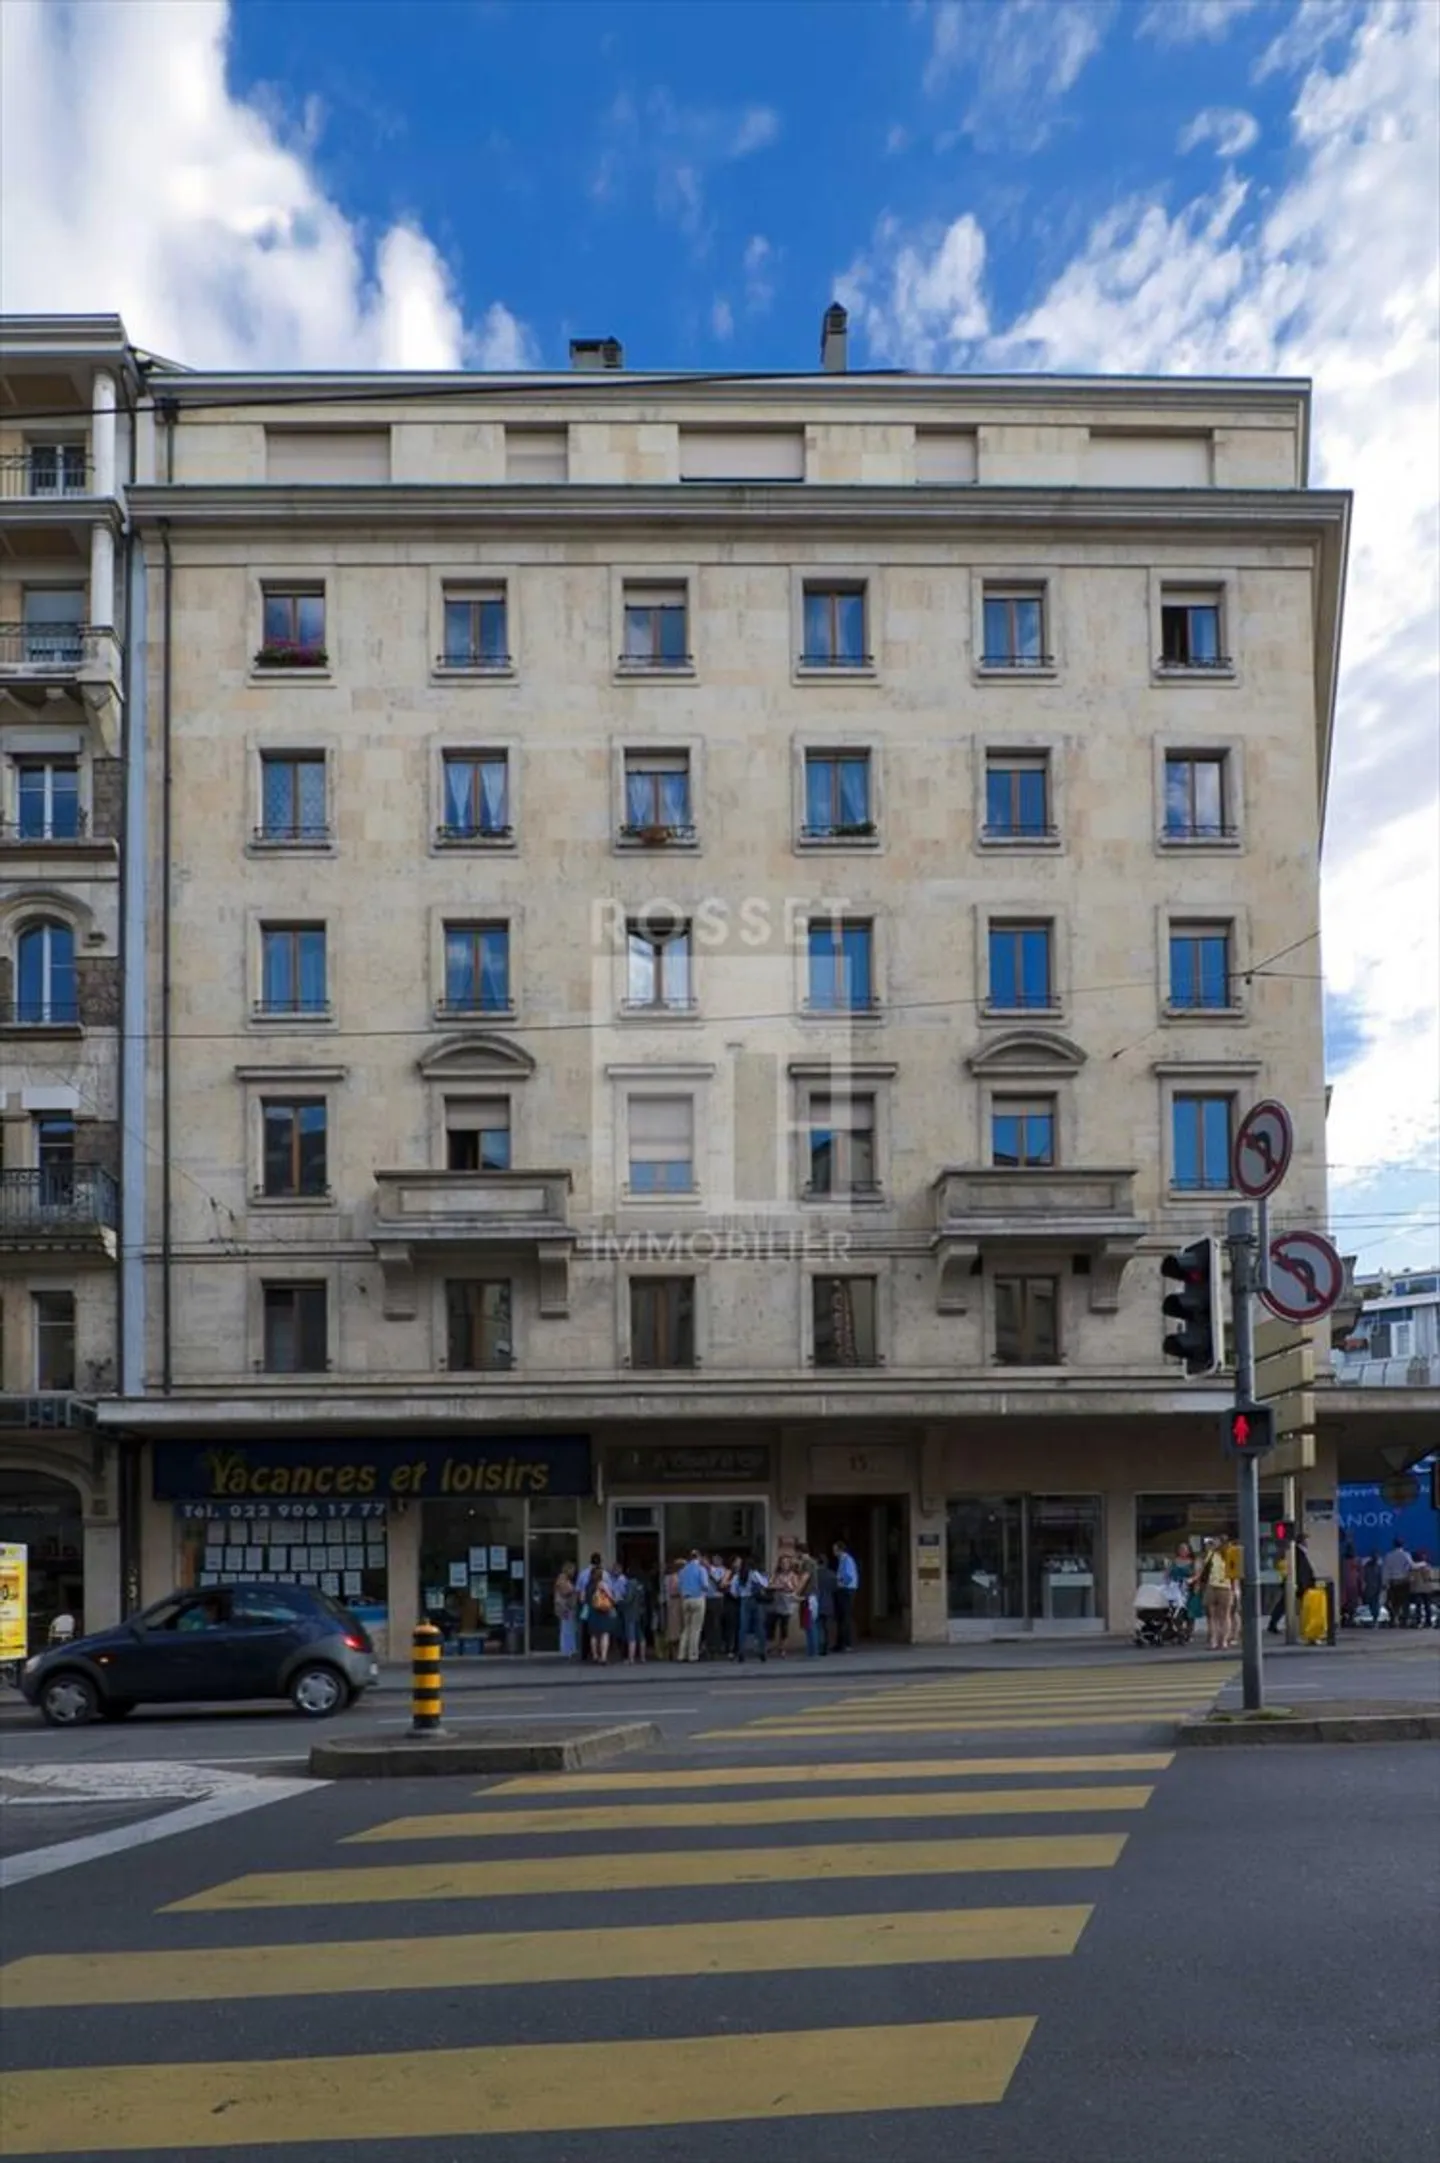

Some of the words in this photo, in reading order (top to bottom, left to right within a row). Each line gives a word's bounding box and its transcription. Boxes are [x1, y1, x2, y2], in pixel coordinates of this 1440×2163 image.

[209, 1451, 376, 1494] Vacances
[389, 1460, 428, 1492] et
[440, 1457, 549, 1491] loisirs
[184, 1504, 219, 1518] Tél.
[229, 1504, 270, 1517] 022
[277, 1503, 318, 1517] 906
[328, 1503, 351, 1516] 17
[361, 1502, 385, 1516] 77
